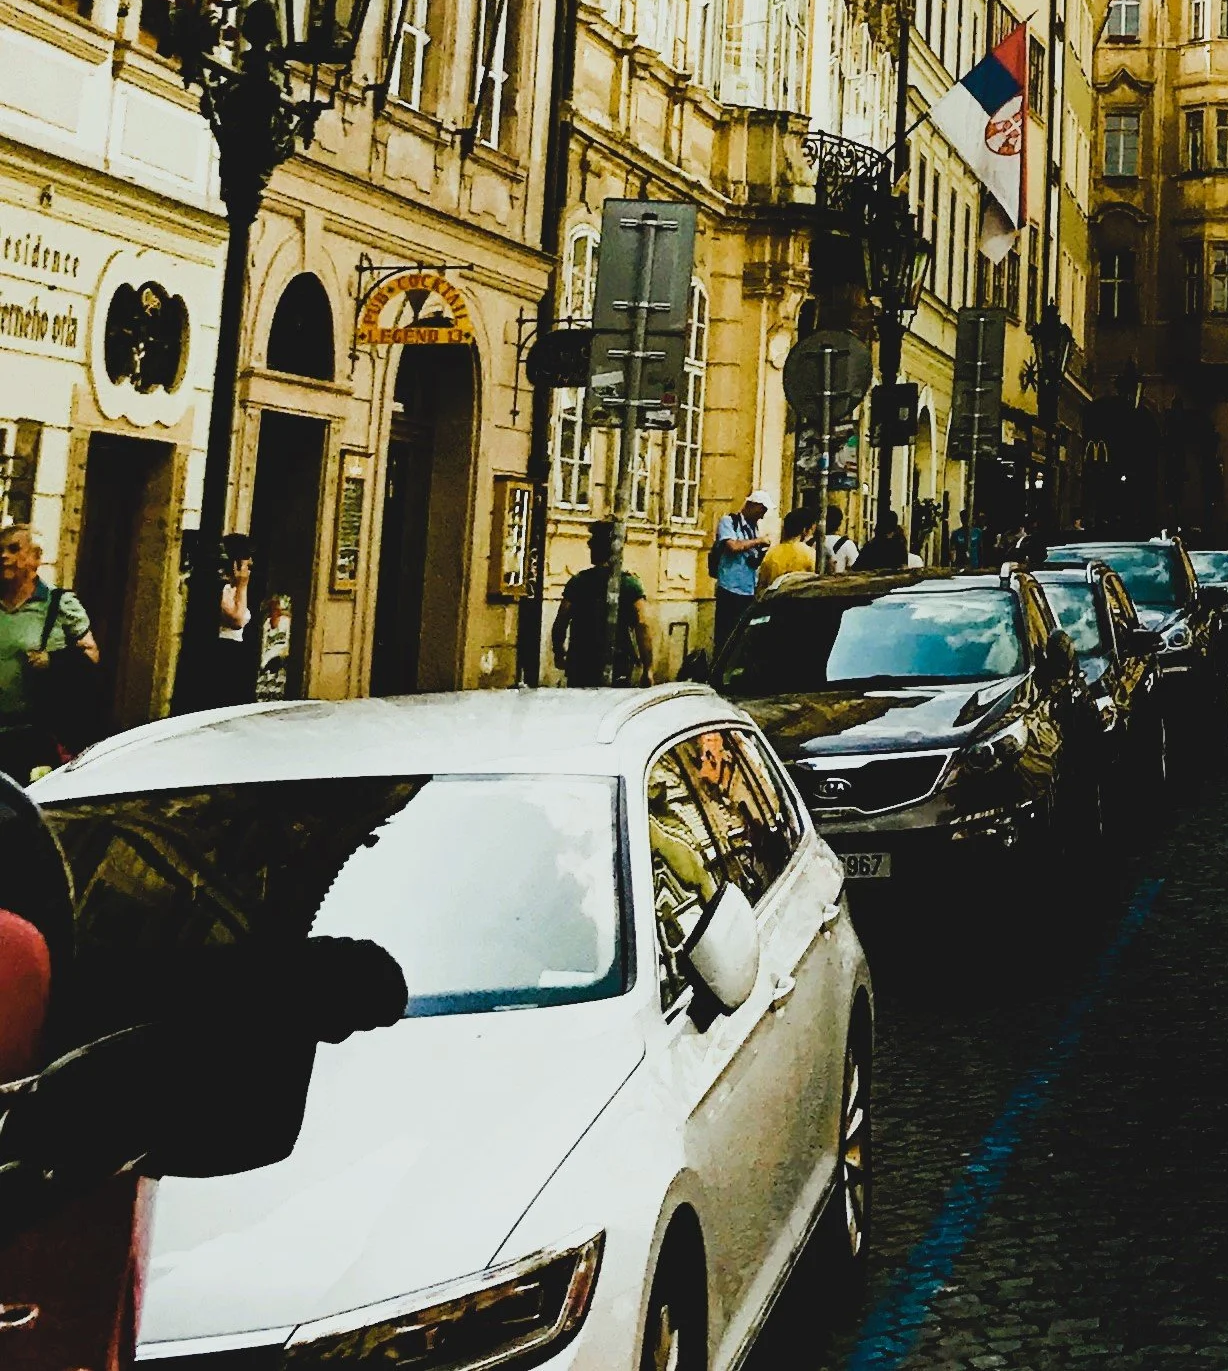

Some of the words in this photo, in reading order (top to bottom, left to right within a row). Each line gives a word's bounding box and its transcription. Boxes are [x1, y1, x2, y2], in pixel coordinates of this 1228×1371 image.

[0, 232, 80, 278] esidence
[362, 287, 390, 326] PUB
[397, 273, 468, 328] COCKTAIL
[367, 329, 439, 344] LEGEND
[447, 329, 464, 343] 13
[839, 855, 883, 877] 967
